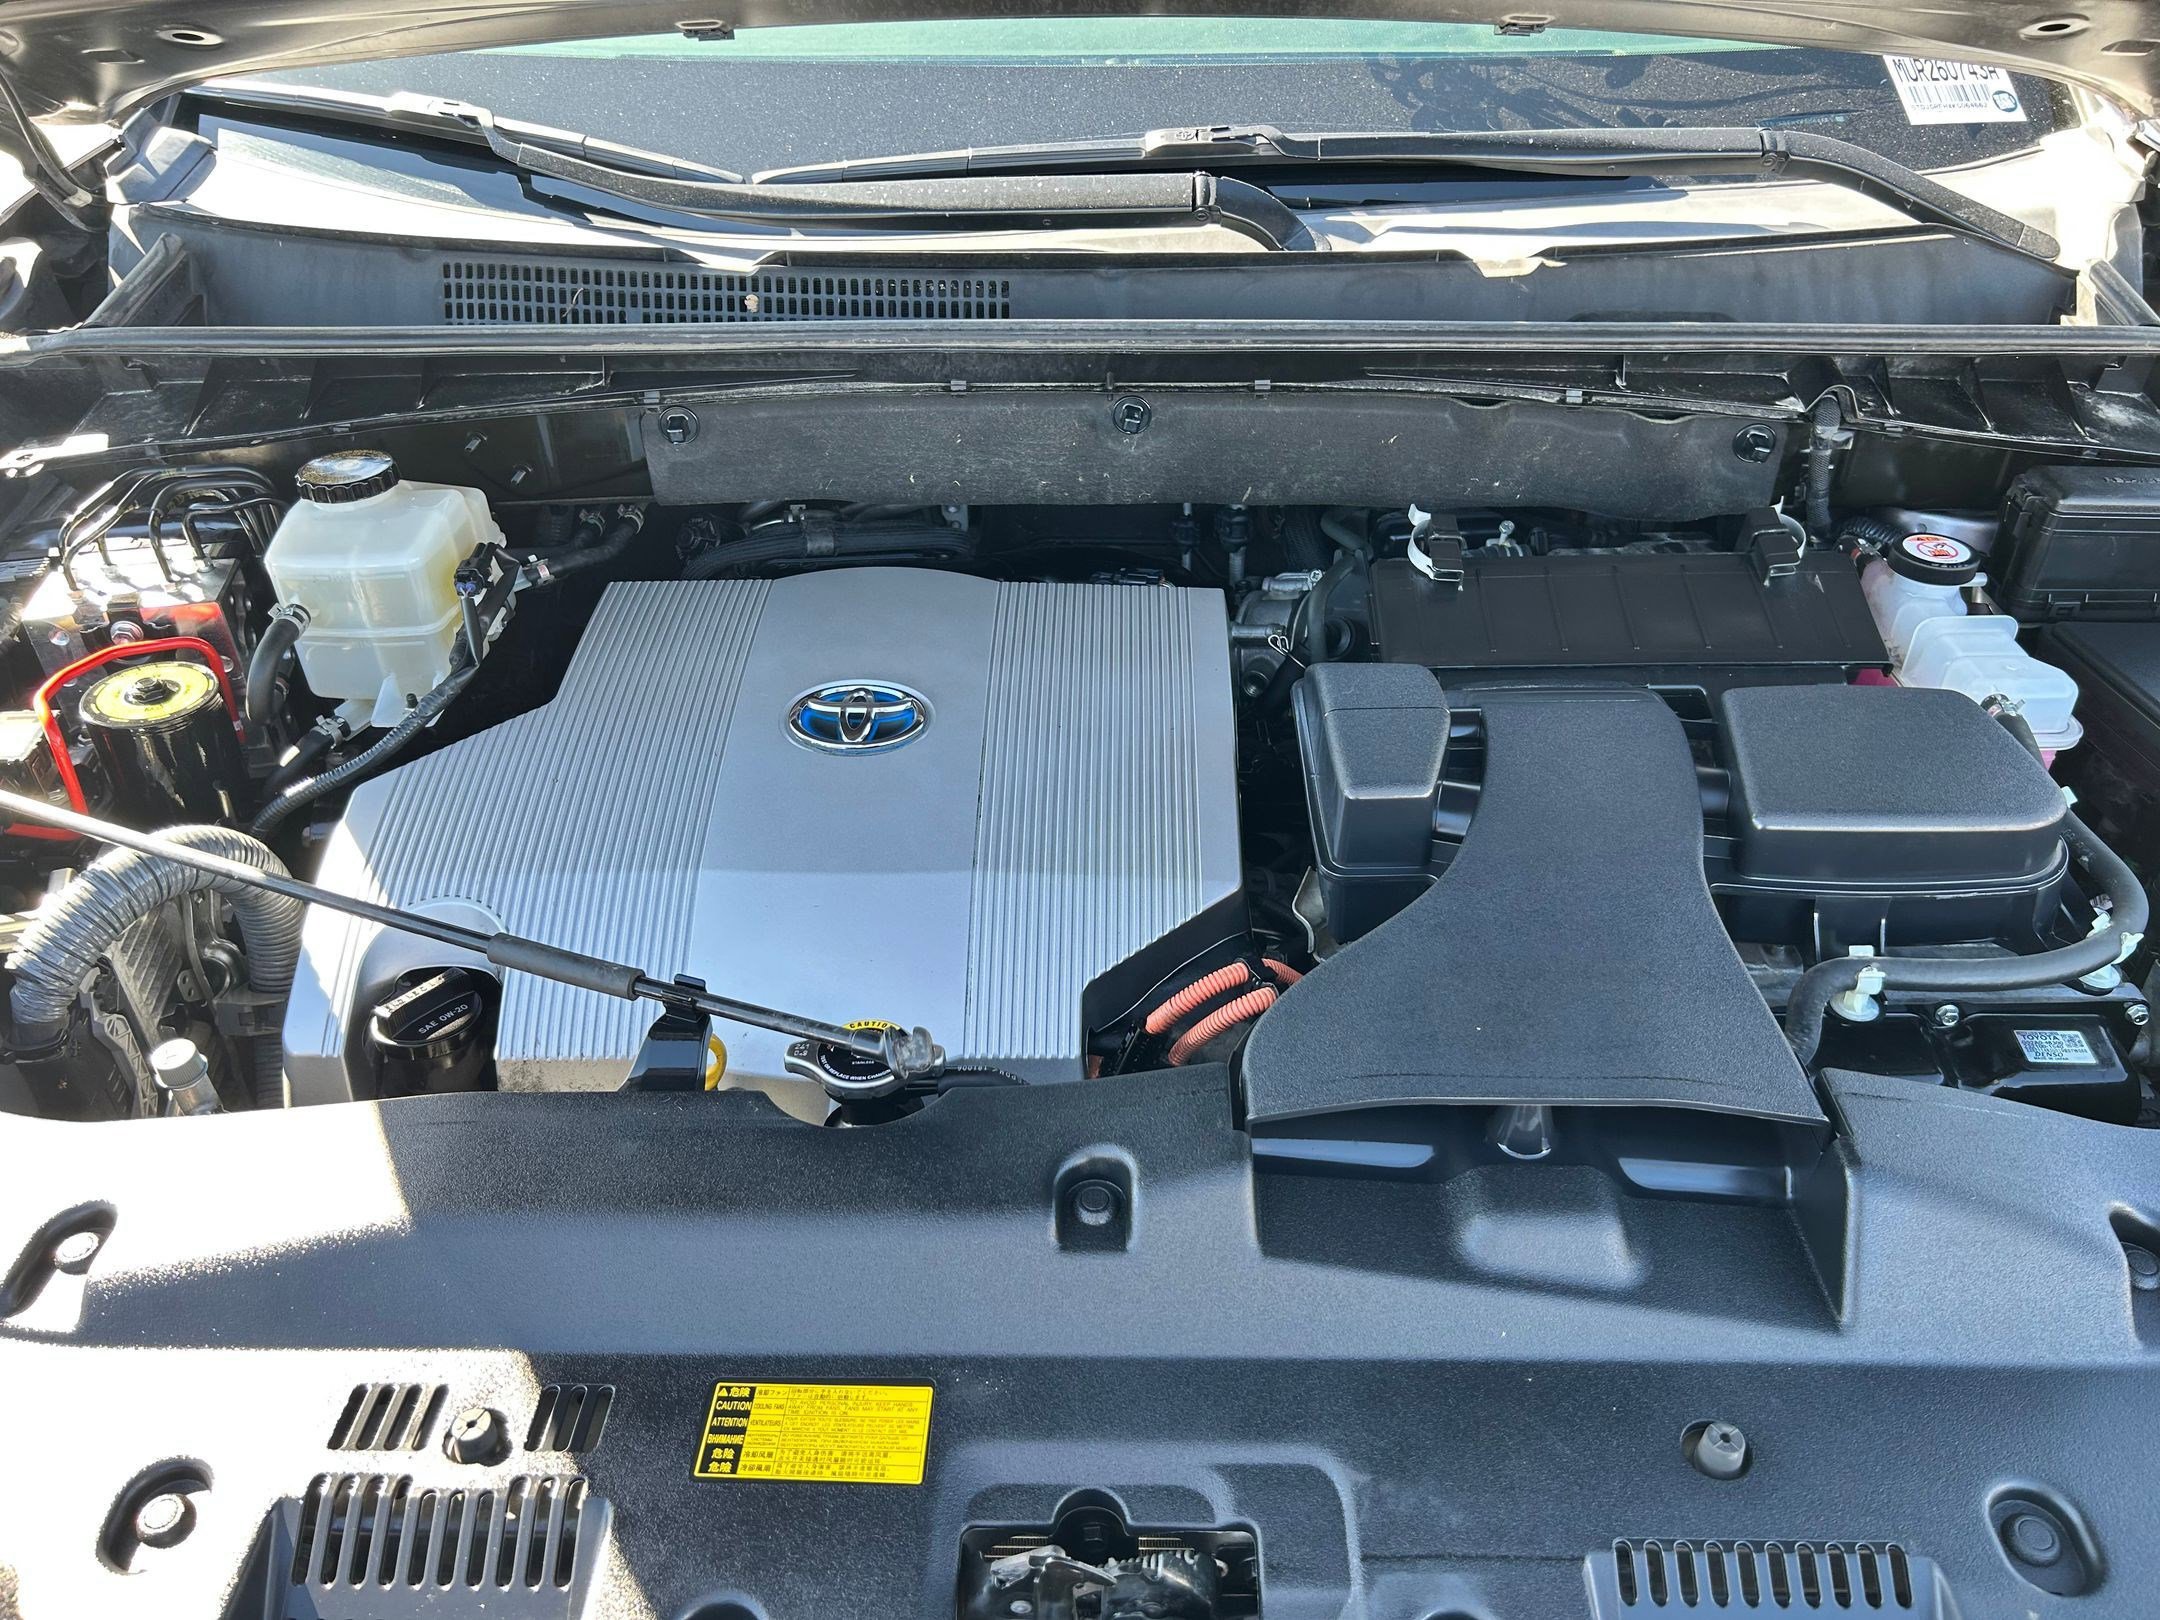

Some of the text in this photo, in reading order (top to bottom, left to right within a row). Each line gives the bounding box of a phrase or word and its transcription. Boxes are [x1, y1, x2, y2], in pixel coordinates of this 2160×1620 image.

[419, 1004, 468, 1034] SAE 0W-20
[849, 1021, 892, 1030] CAUTIO
[829, 1068, 850, 1080] REPLACE
[716, 1400, 753, 1411] CAUTION
[711, 1416, 749, 1428] ATTENTION
[706, 1433, 746, 1445] ВНИМАНИЕ
